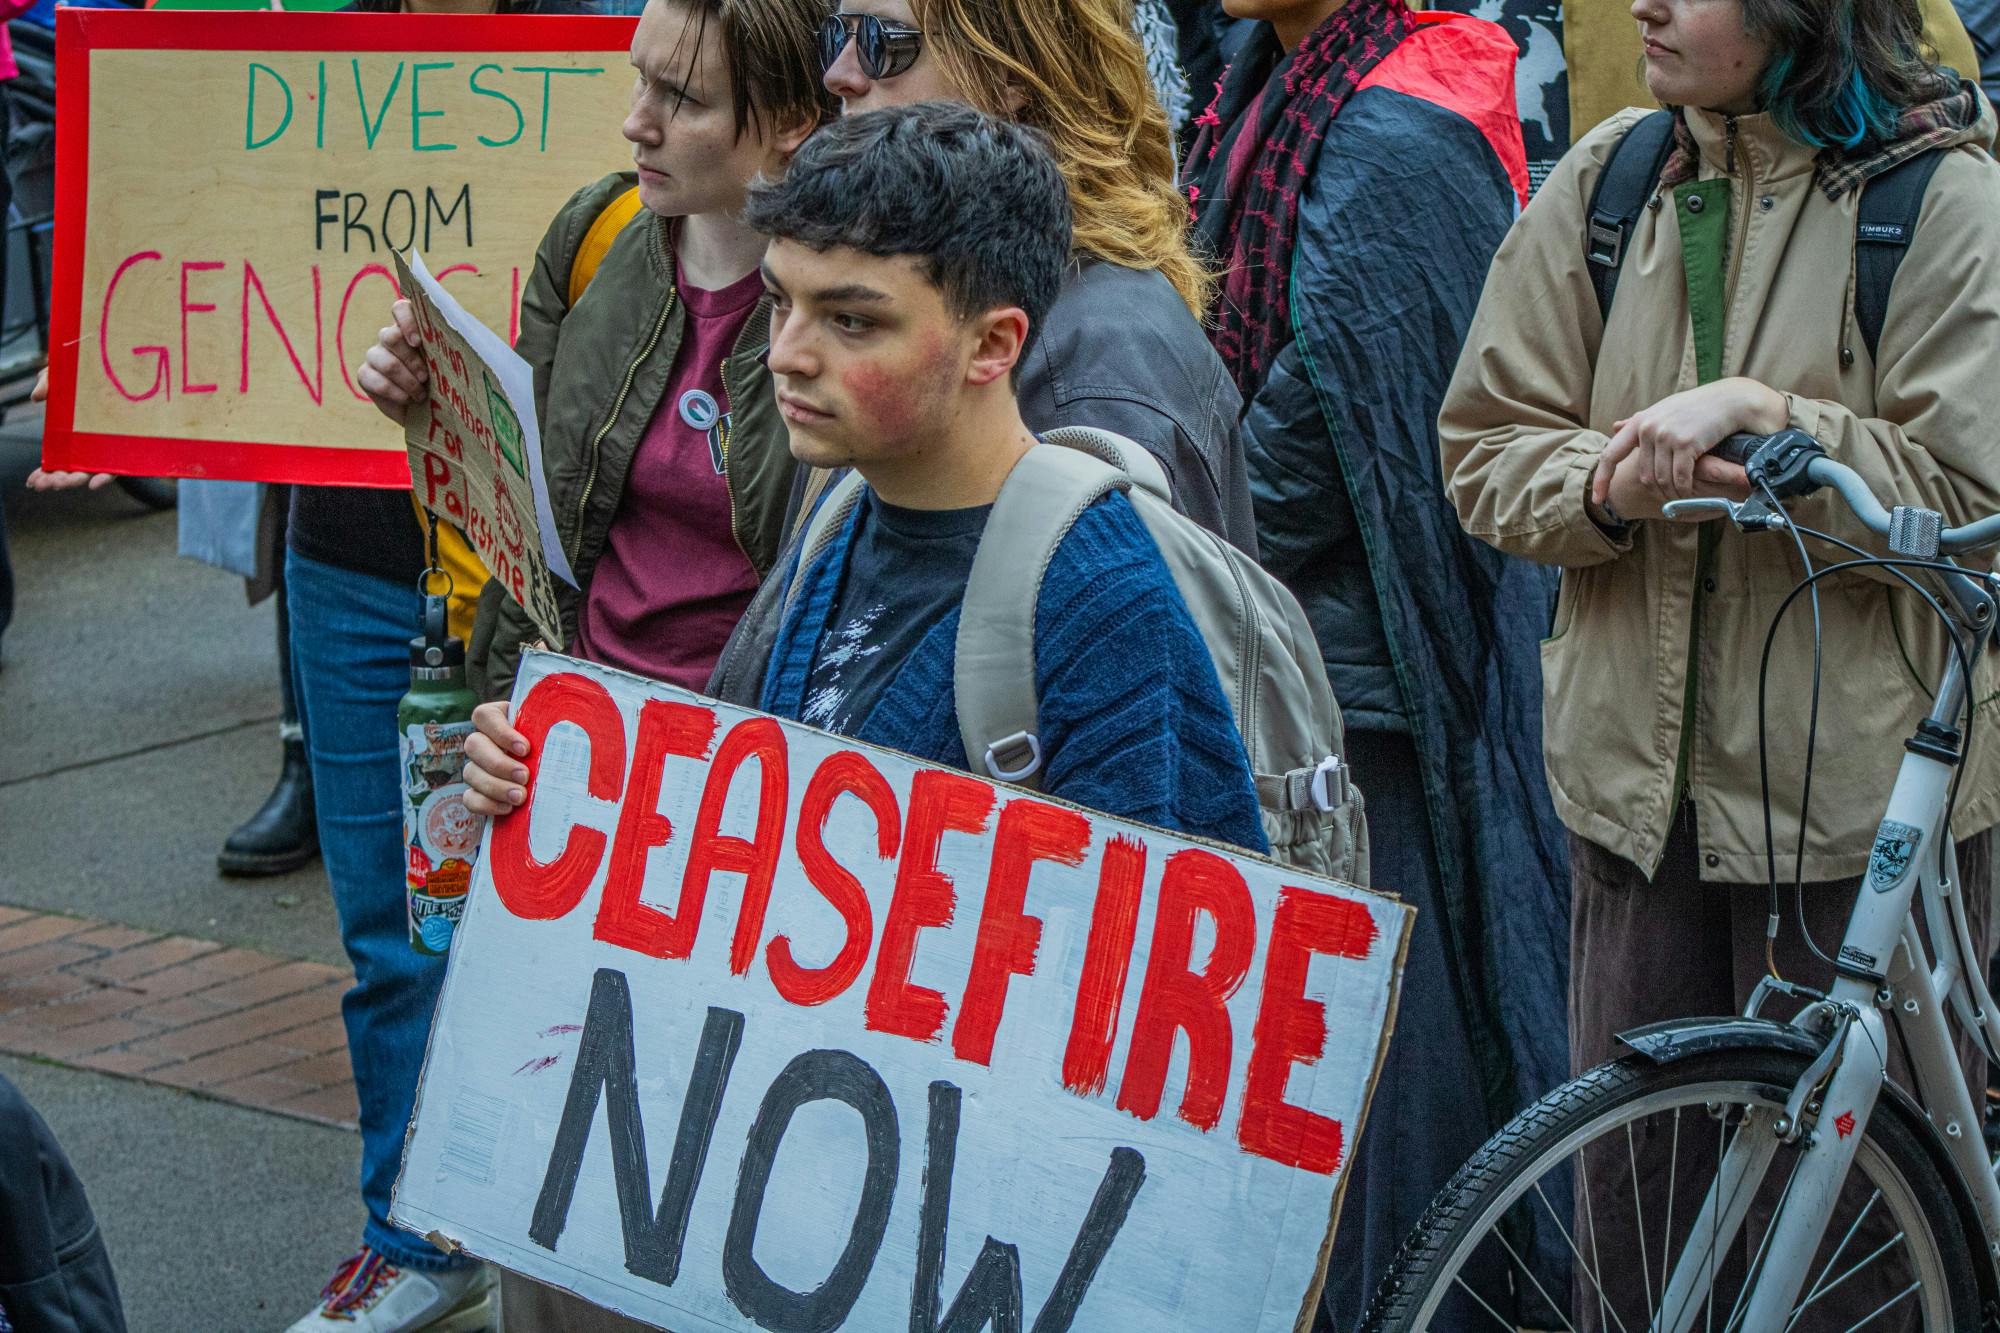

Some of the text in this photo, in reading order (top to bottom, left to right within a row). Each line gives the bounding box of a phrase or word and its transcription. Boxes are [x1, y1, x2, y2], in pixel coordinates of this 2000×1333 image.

[246, 59, 604, 152] DIVEST
[315, 184, 472, 253] FROM
[1860, 226, 1902, 235] TIMBUK2
[424, 451, 525, 609] Palestine
[490, 673, 1379, 1176] CEASEFIRE
[528, 968, 1147, 1333] NOW
